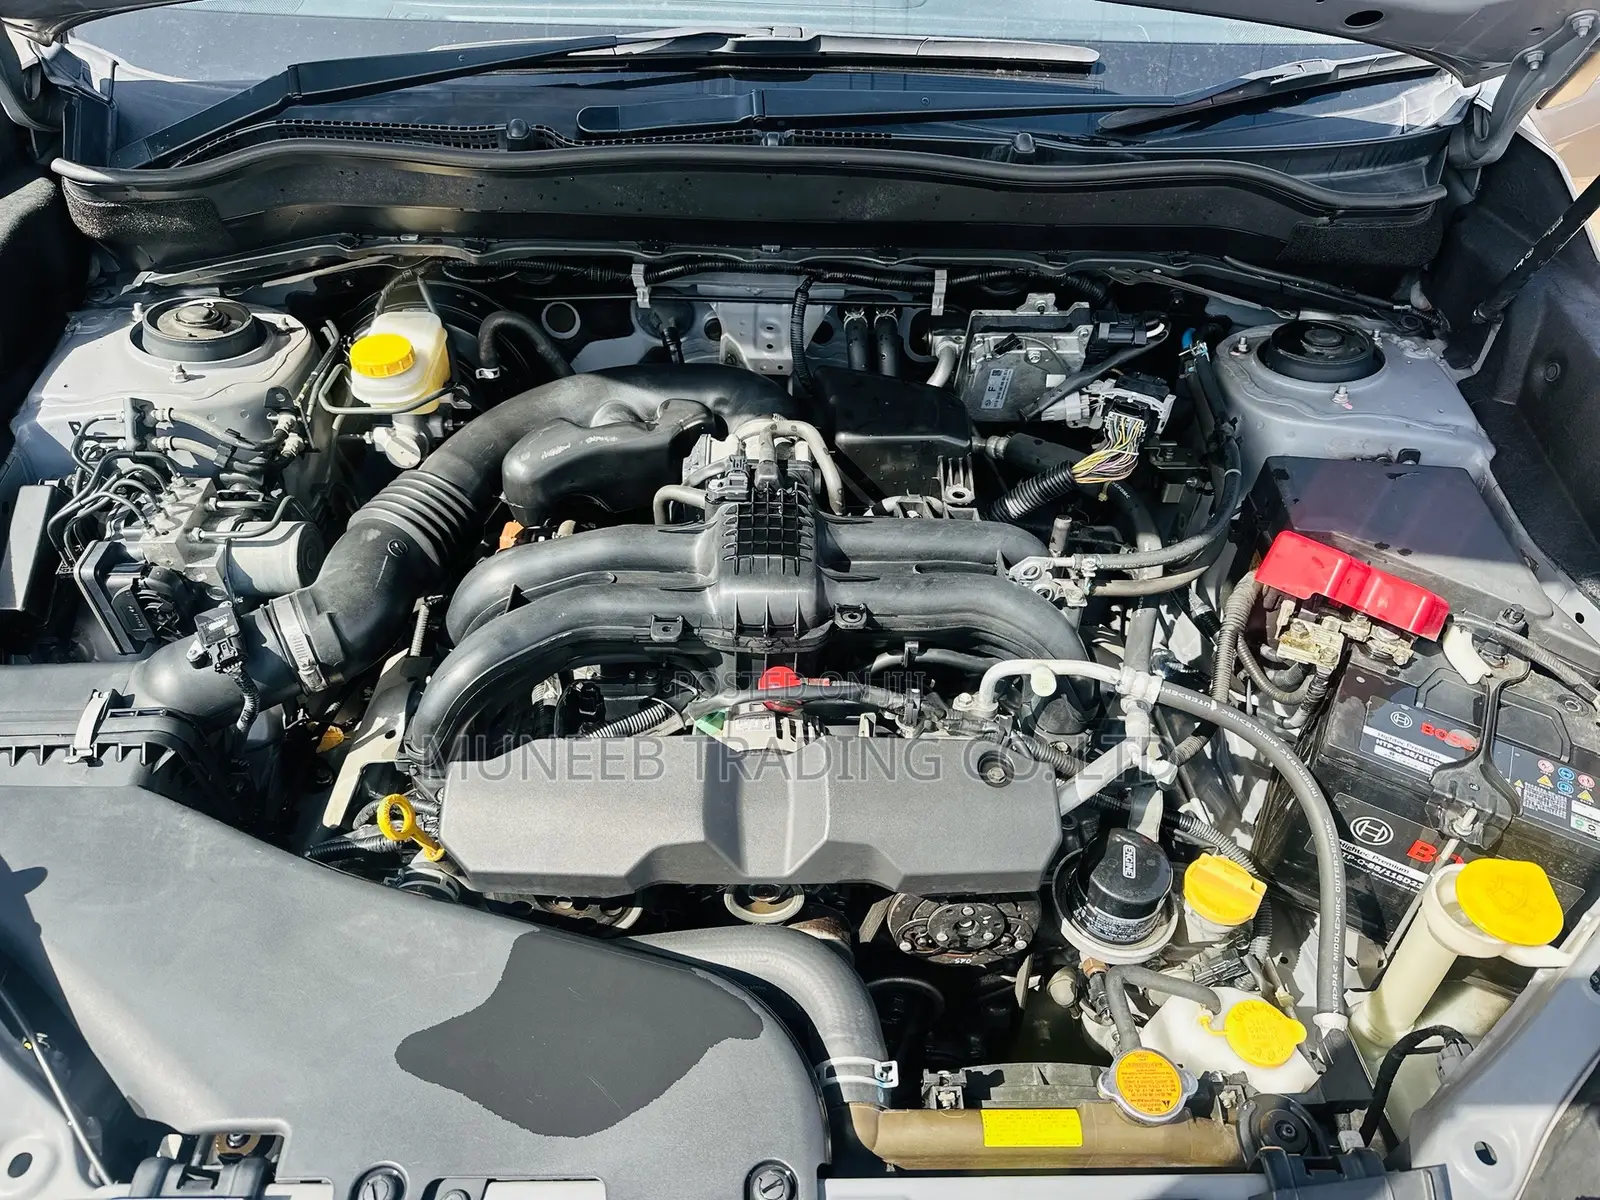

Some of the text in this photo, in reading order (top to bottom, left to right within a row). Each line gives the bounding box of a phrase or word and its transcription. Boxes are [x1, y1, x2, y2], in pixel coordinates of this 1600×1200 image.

[1160, 687, 1217, 711] UTER>EP
[1420, 720, 1477, 752] BOSC
[1124, 847, 1135, 877] ENGINE
[1371, 854, 1410, 875] Premium
